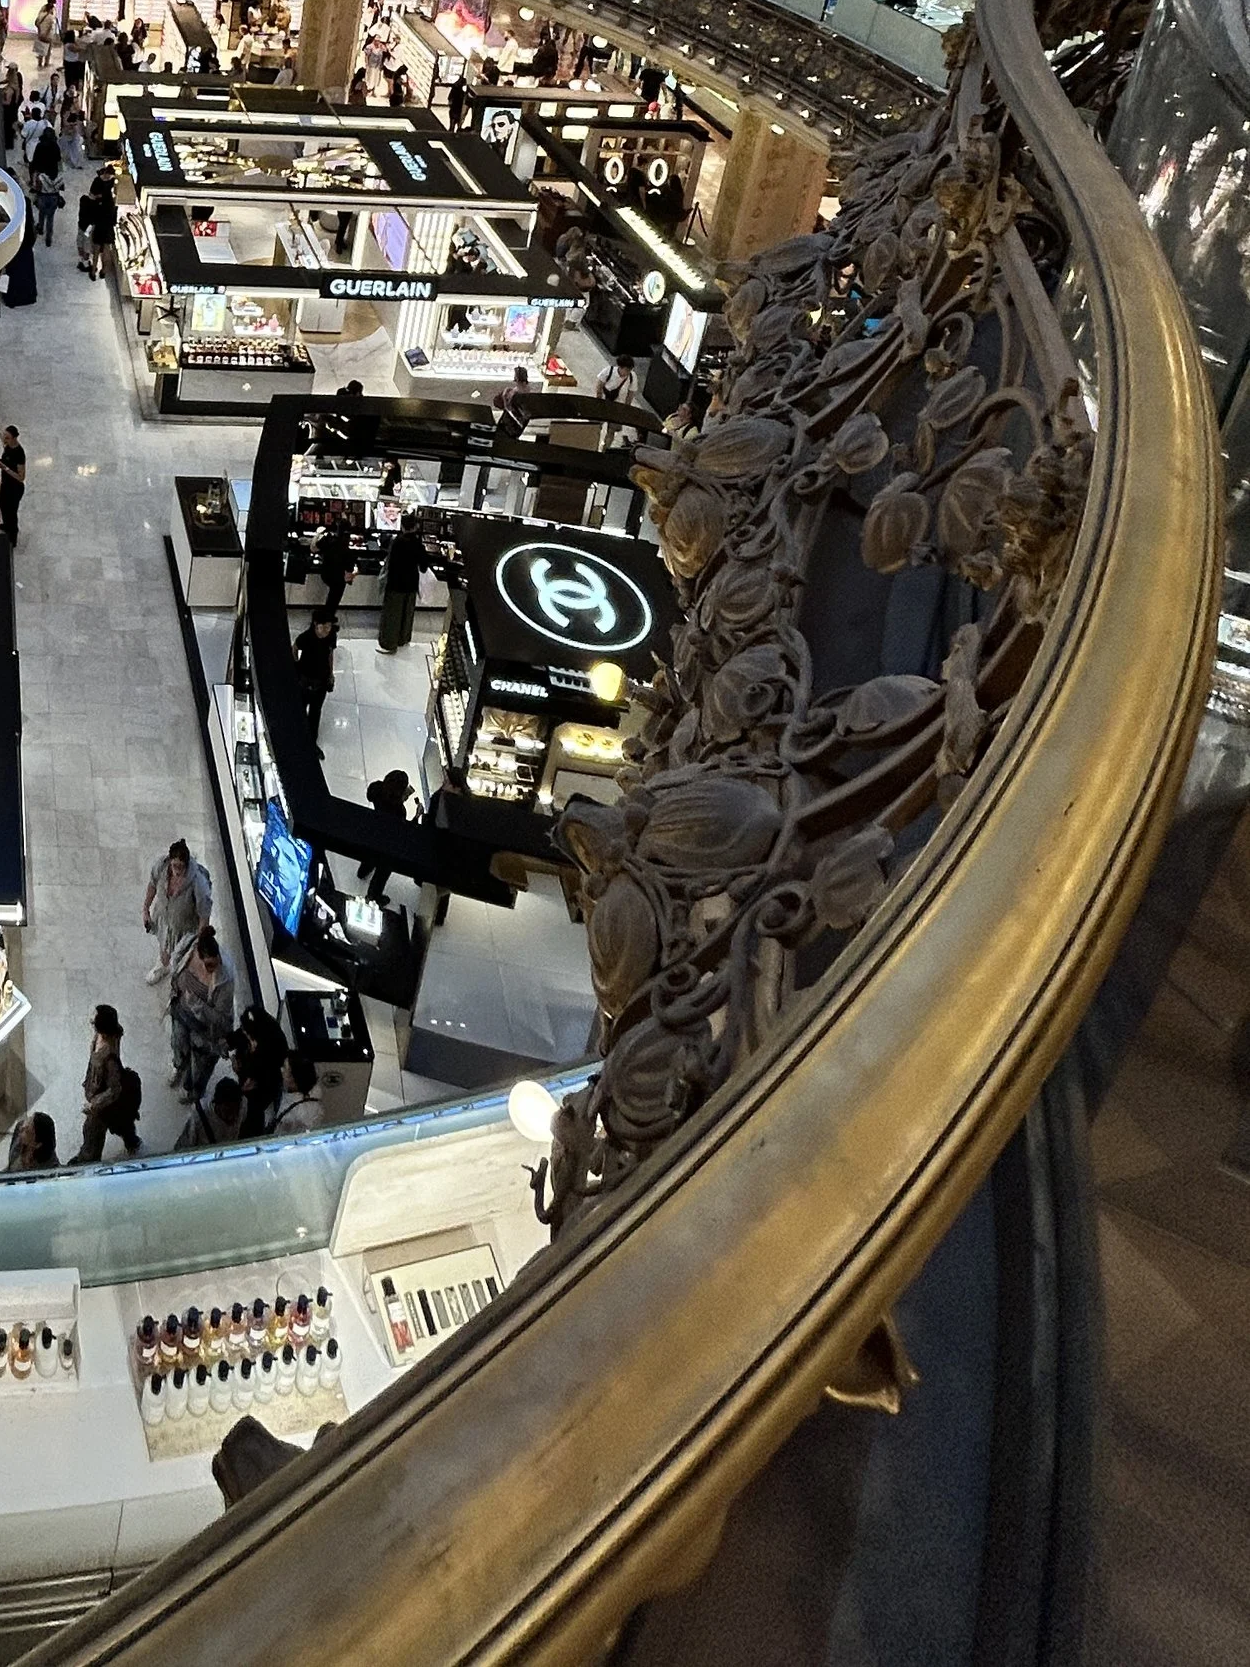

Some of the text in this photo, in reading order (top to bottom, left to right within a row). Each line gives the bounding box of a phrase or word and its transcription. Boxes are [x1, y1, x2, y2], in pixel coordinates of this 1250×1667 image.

[149, 132, 173, 172] GUERLAIN
[389, 140, 427, 182] GUERLAIN
[330, 278, 432, 298] GUERLAIN
[490, 679, 549, 698] CHANEL
